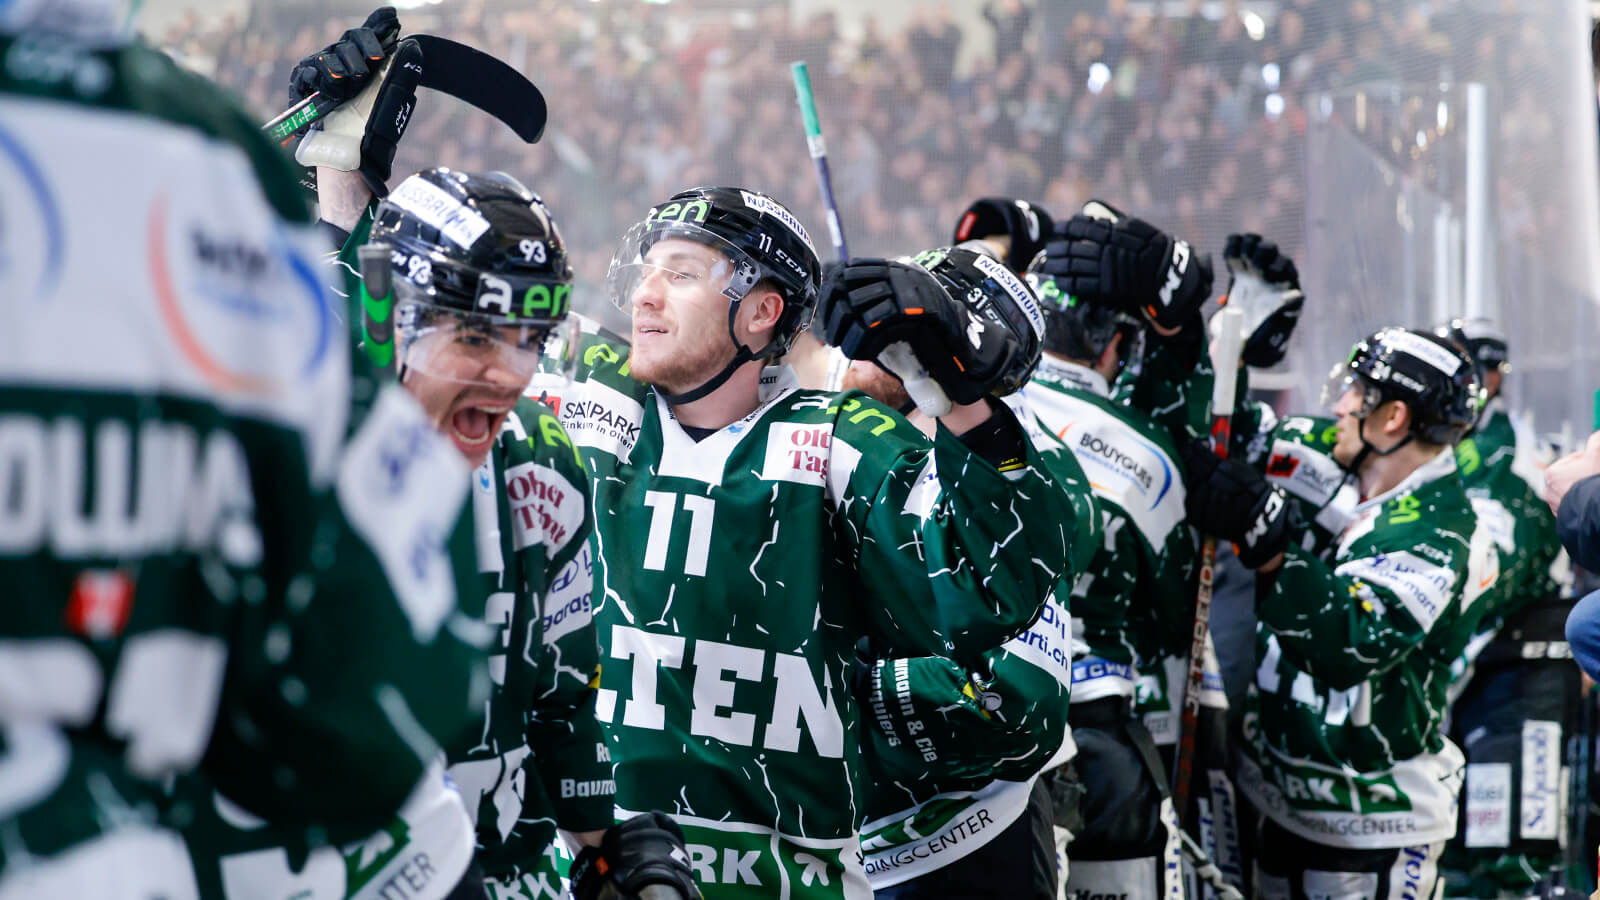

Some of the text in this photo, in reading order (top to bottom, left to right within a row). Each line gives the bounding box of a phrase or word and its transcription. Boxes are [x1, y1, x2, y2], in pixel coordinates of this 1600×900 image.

[519, 239, 547, 263] 93
[759, 233, 808, 278] 11 CCM
[407, 254, 432, 284] 93
[967, 287, 989, 310] 31
[643, 490, 716, 577] 11
[914, 737, 938, 763] Cie
